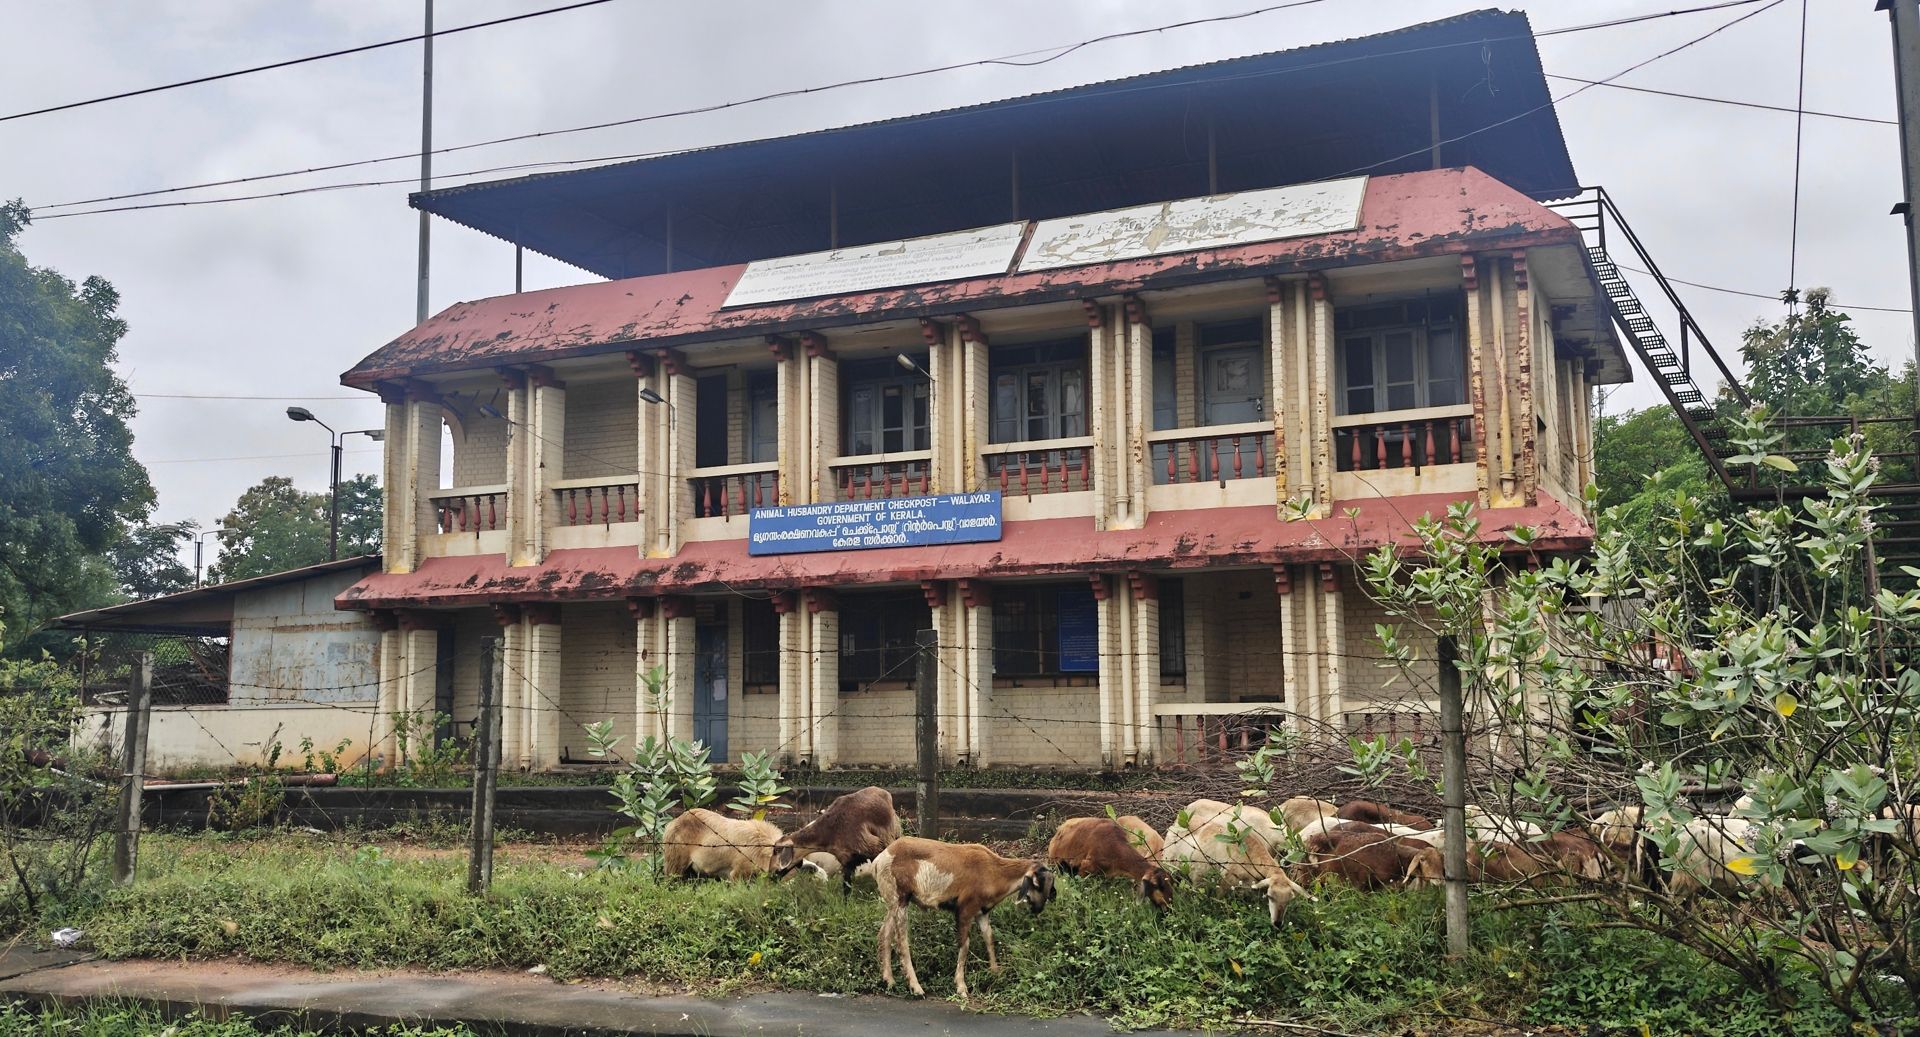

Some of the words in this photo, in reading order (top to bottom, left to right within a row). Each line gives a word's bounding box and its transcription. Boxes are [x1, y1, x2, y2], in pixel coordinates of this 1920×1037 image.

[754, 508, 784, 518] ANIMAL
[787, 505, 832, 516] HUSBANDRY
[834, 501, 885, 513] DEPARTMENT
[887, 497, 937, 509] CHECKPOST
[950, 493, 994, 505] WALAYAR.
[816, 512, 871, 525] GOVERNMENT
[875, 512, 886, 521] OF
[890, 509, 926, 520] KERALA.
